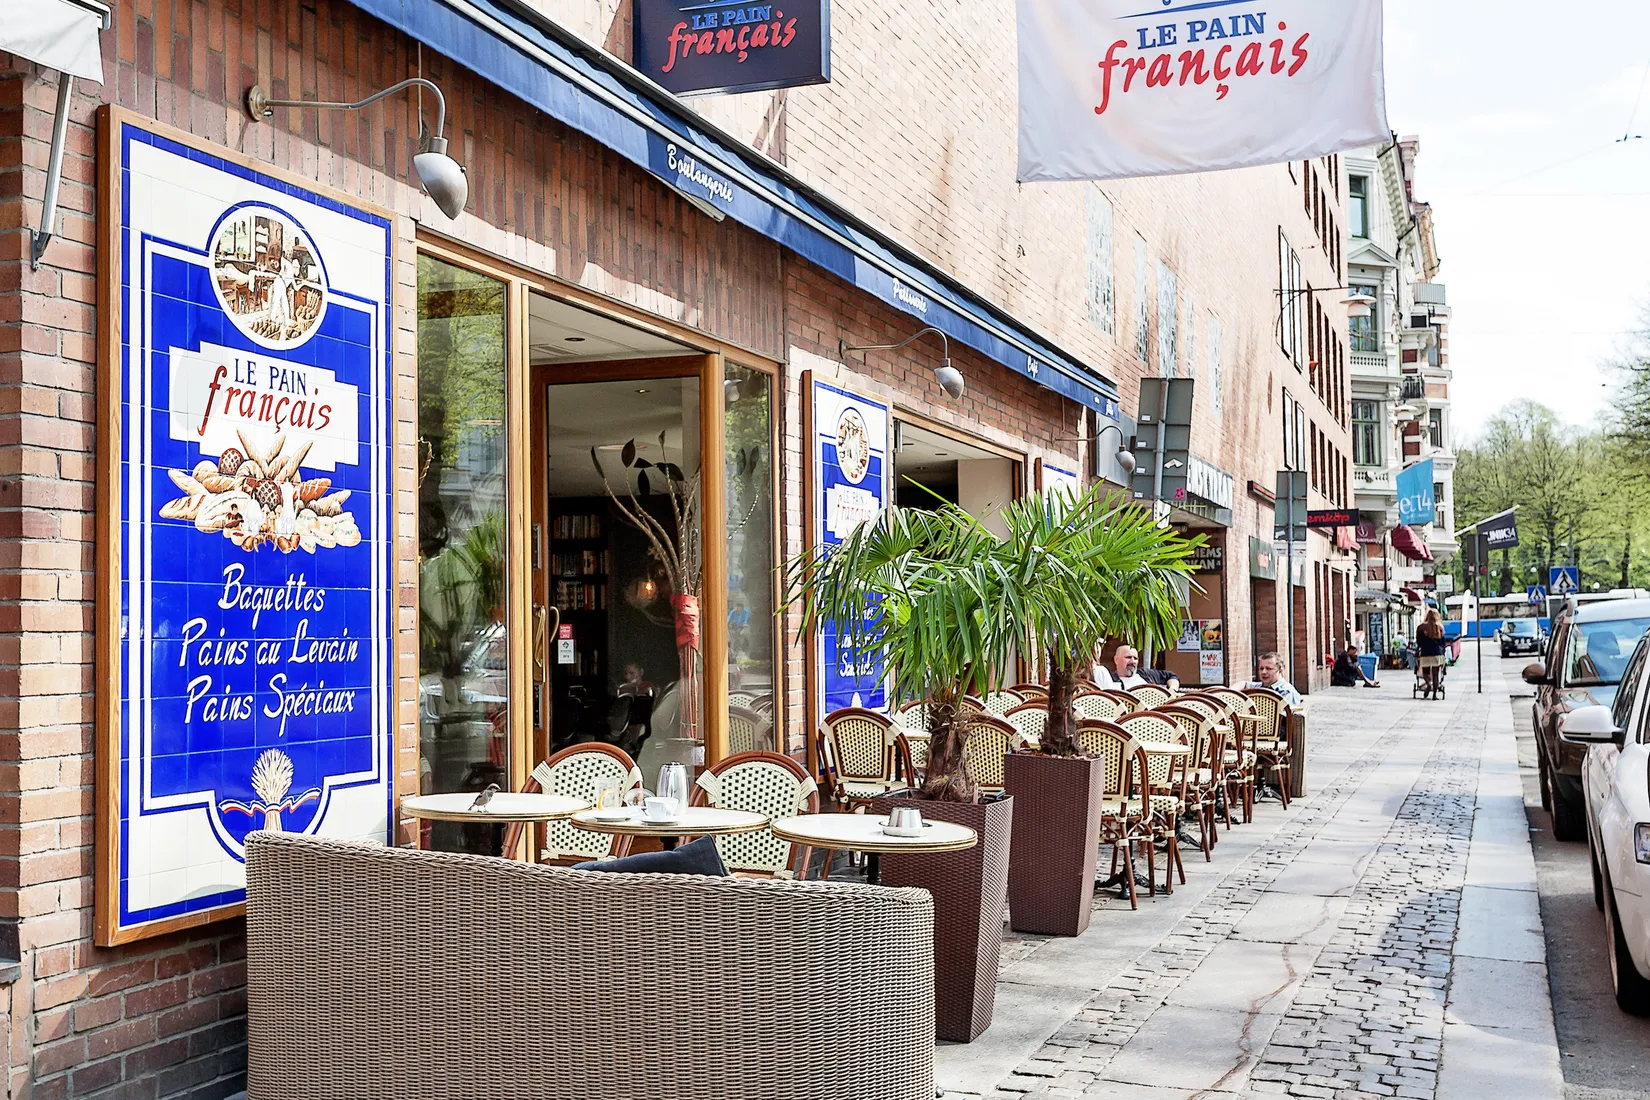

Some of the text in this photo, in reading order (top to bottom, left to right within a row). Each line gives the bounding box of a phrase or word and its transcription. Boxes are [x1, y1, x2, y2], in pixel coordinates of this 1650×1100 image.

[661, 10, 797, 73] français
[692, 5, 772, 31] LE PAIN
[1136, 12, 1267, 50] LE PAIN
[1094, 21, 1310, 115] français
[667, 143, 733, 203] Boulangerie
[197, 365, 332, 436] français
[234, 358, 307, 396] LE PAIN
[1307, 512, 1350, 524] emköp
[1188, 547, 1222, 559] HEMS
[218, 562, 326, 630] Baguettes
[179, 617, 359, 667] Pains au Levain
[184, 672, 356, 737] Pains Spéciaux
